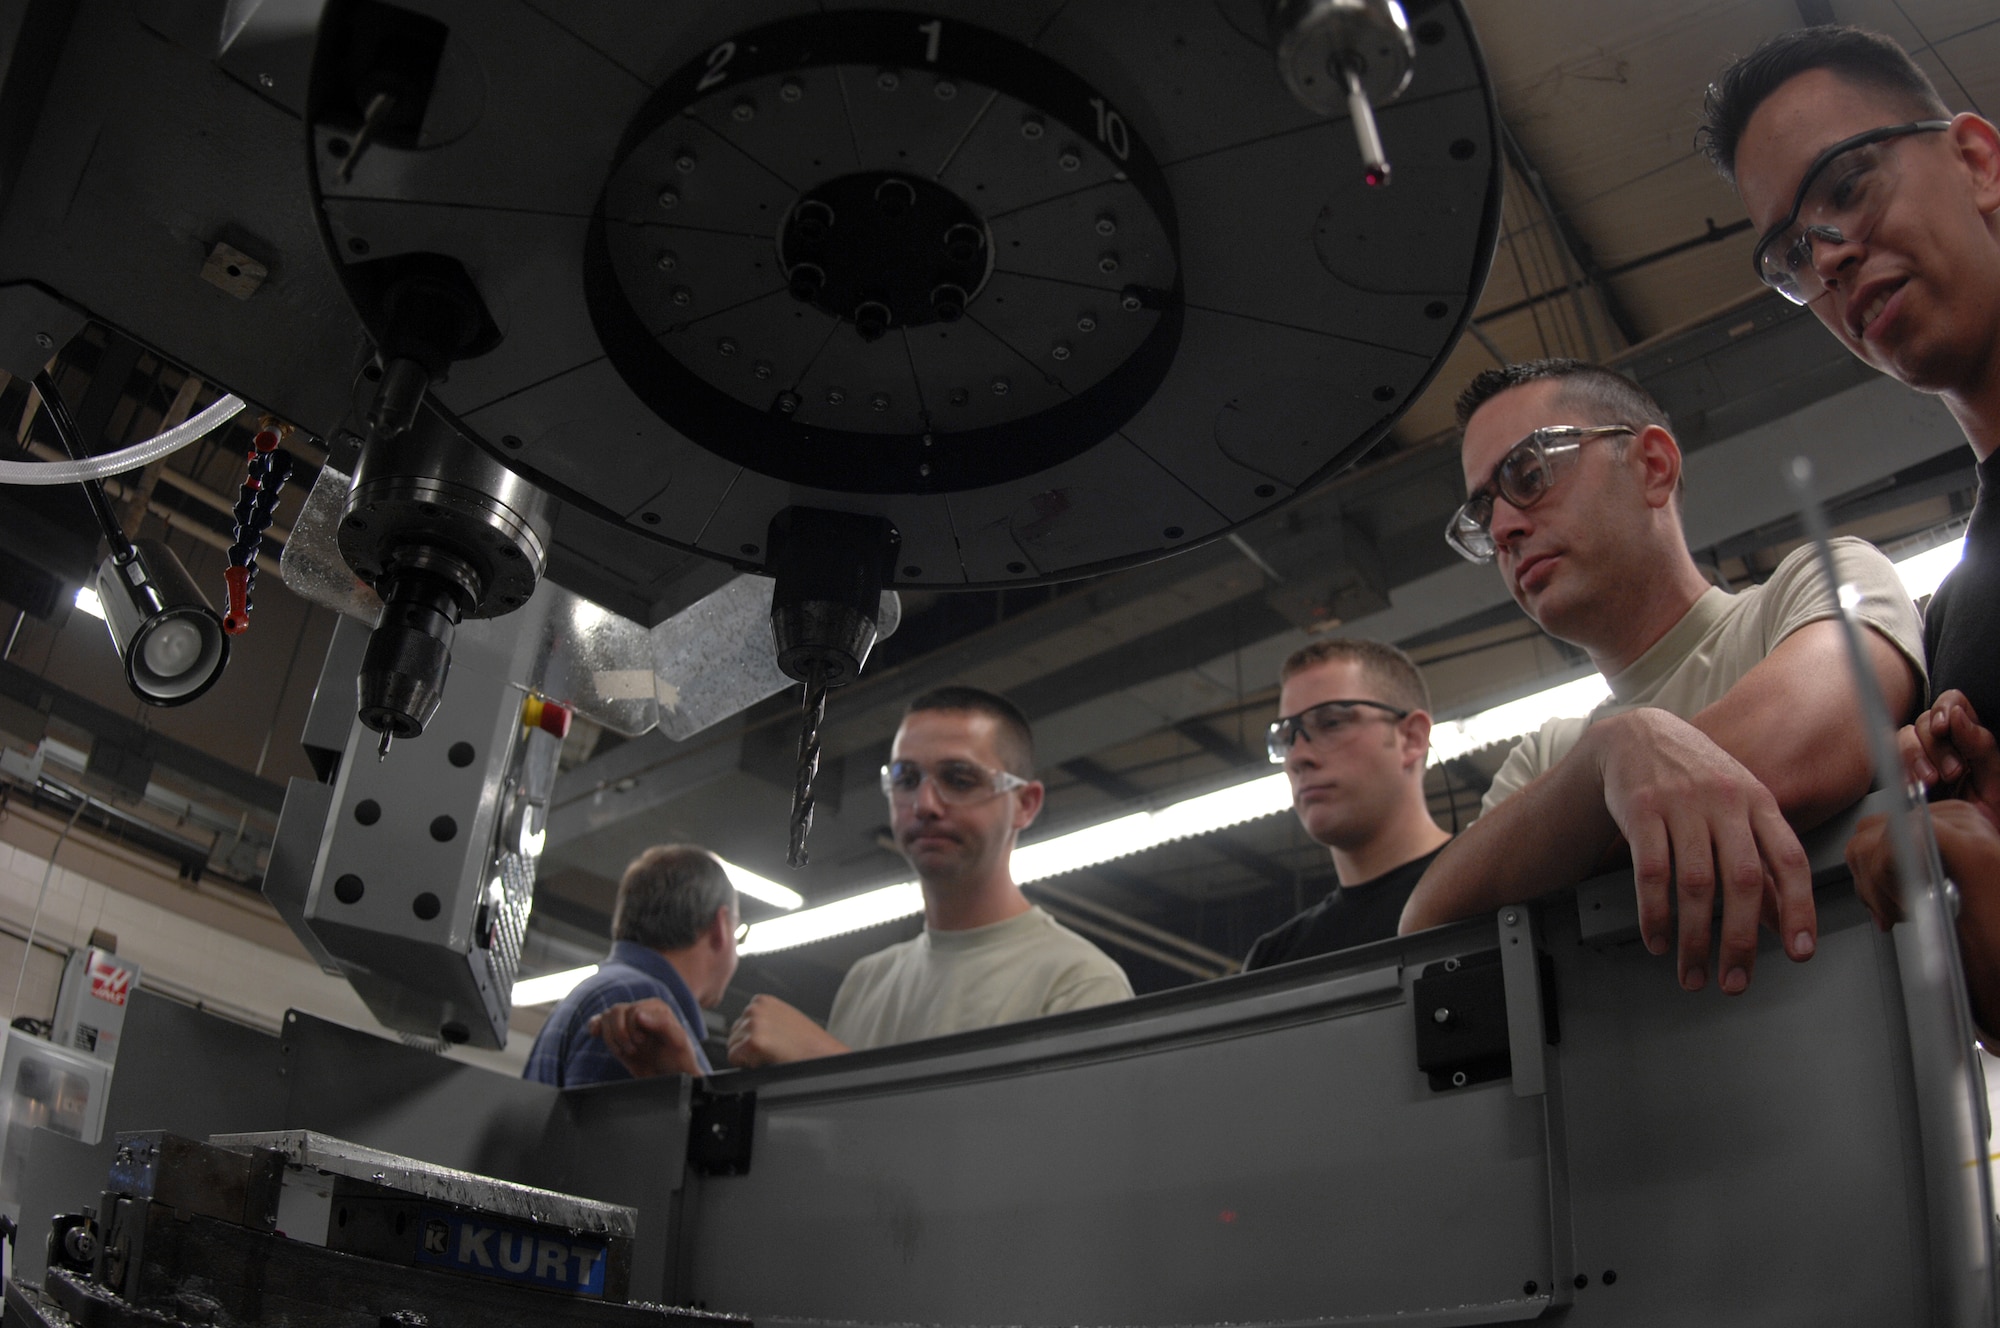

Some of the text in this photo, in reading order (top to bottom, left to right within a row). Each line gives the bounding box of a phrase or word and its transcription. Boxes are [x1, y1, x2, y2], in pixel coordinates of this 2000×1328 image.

[696, 41, 736, 92] 2
[918, 19, 942, 63] 1
[1088, 98, 1128, 161] 10
[424, 1228, 447, 1252] K
[458, 1223, 602, 1286] KURT
